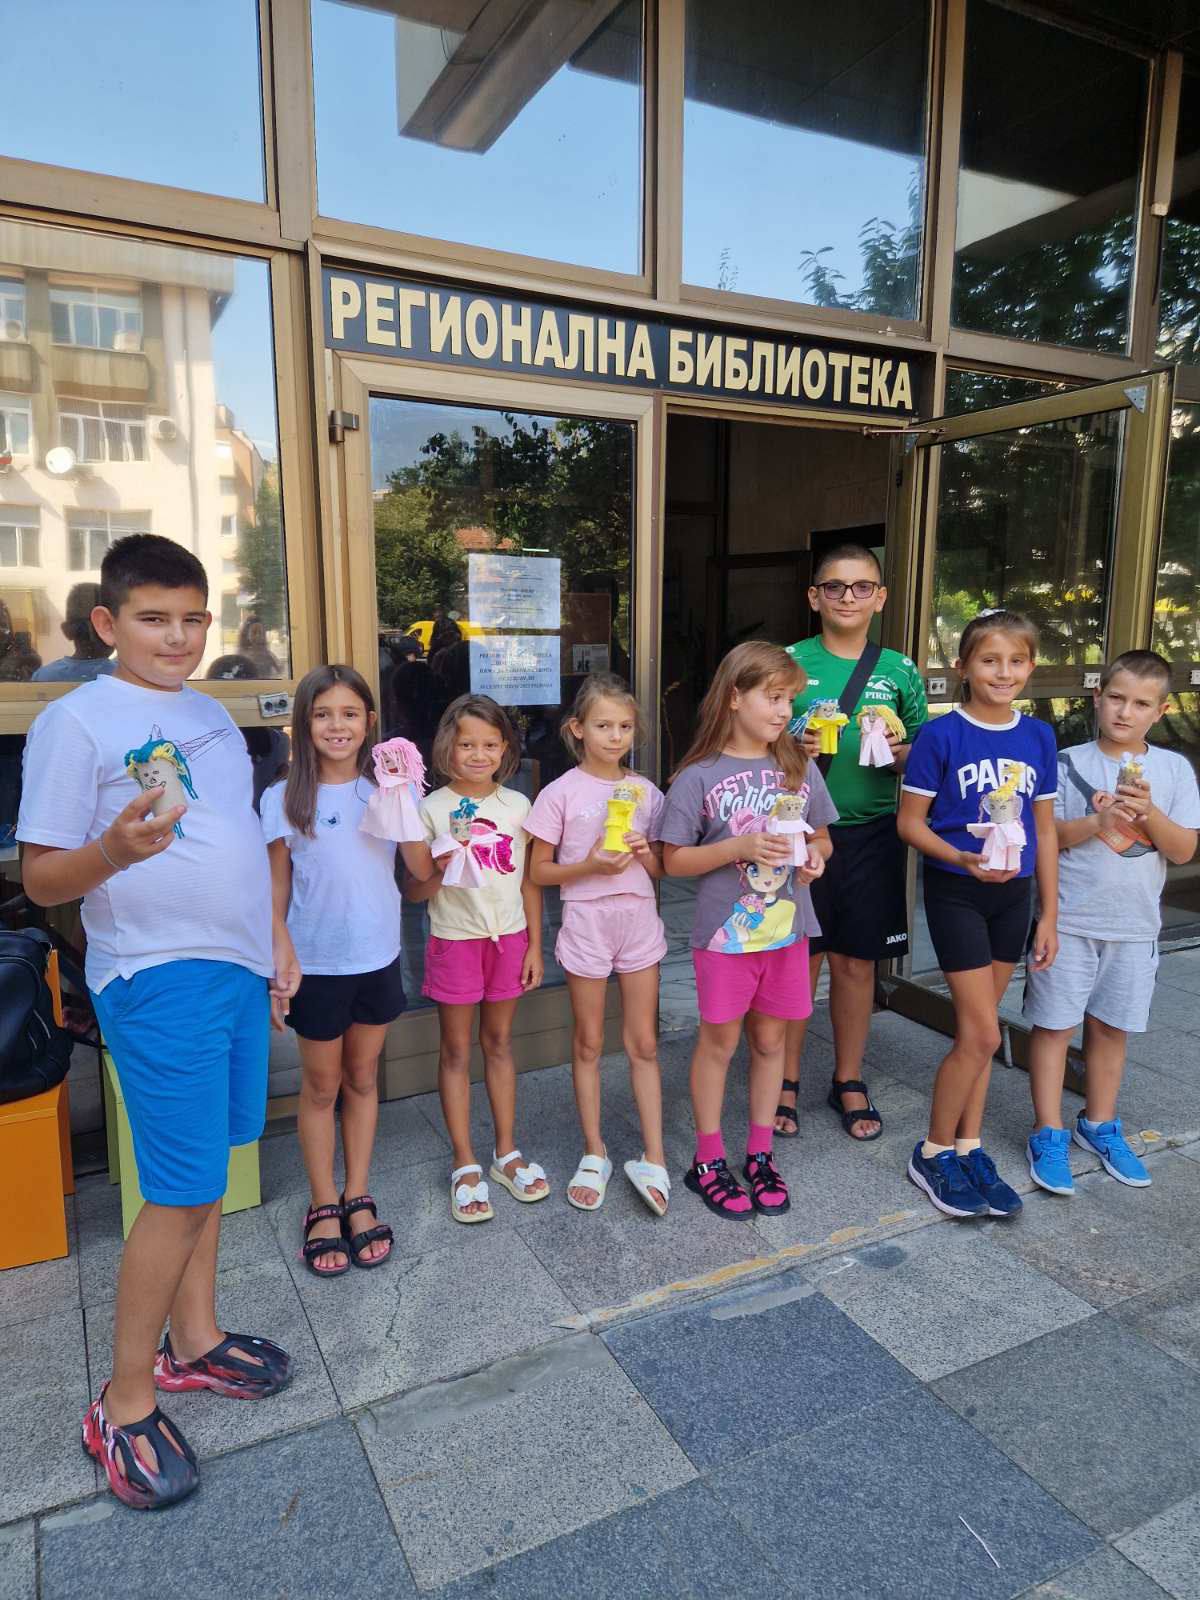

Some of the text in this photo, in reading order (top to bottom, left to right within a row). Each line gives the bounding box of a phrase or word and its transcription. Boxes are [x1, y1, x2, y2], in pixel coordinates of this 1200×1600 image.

[330, 277, 913, 410] РЕГИОНАЛНА БИБЛИОТЕКА
[886, 932, 908, 945] JAKO
